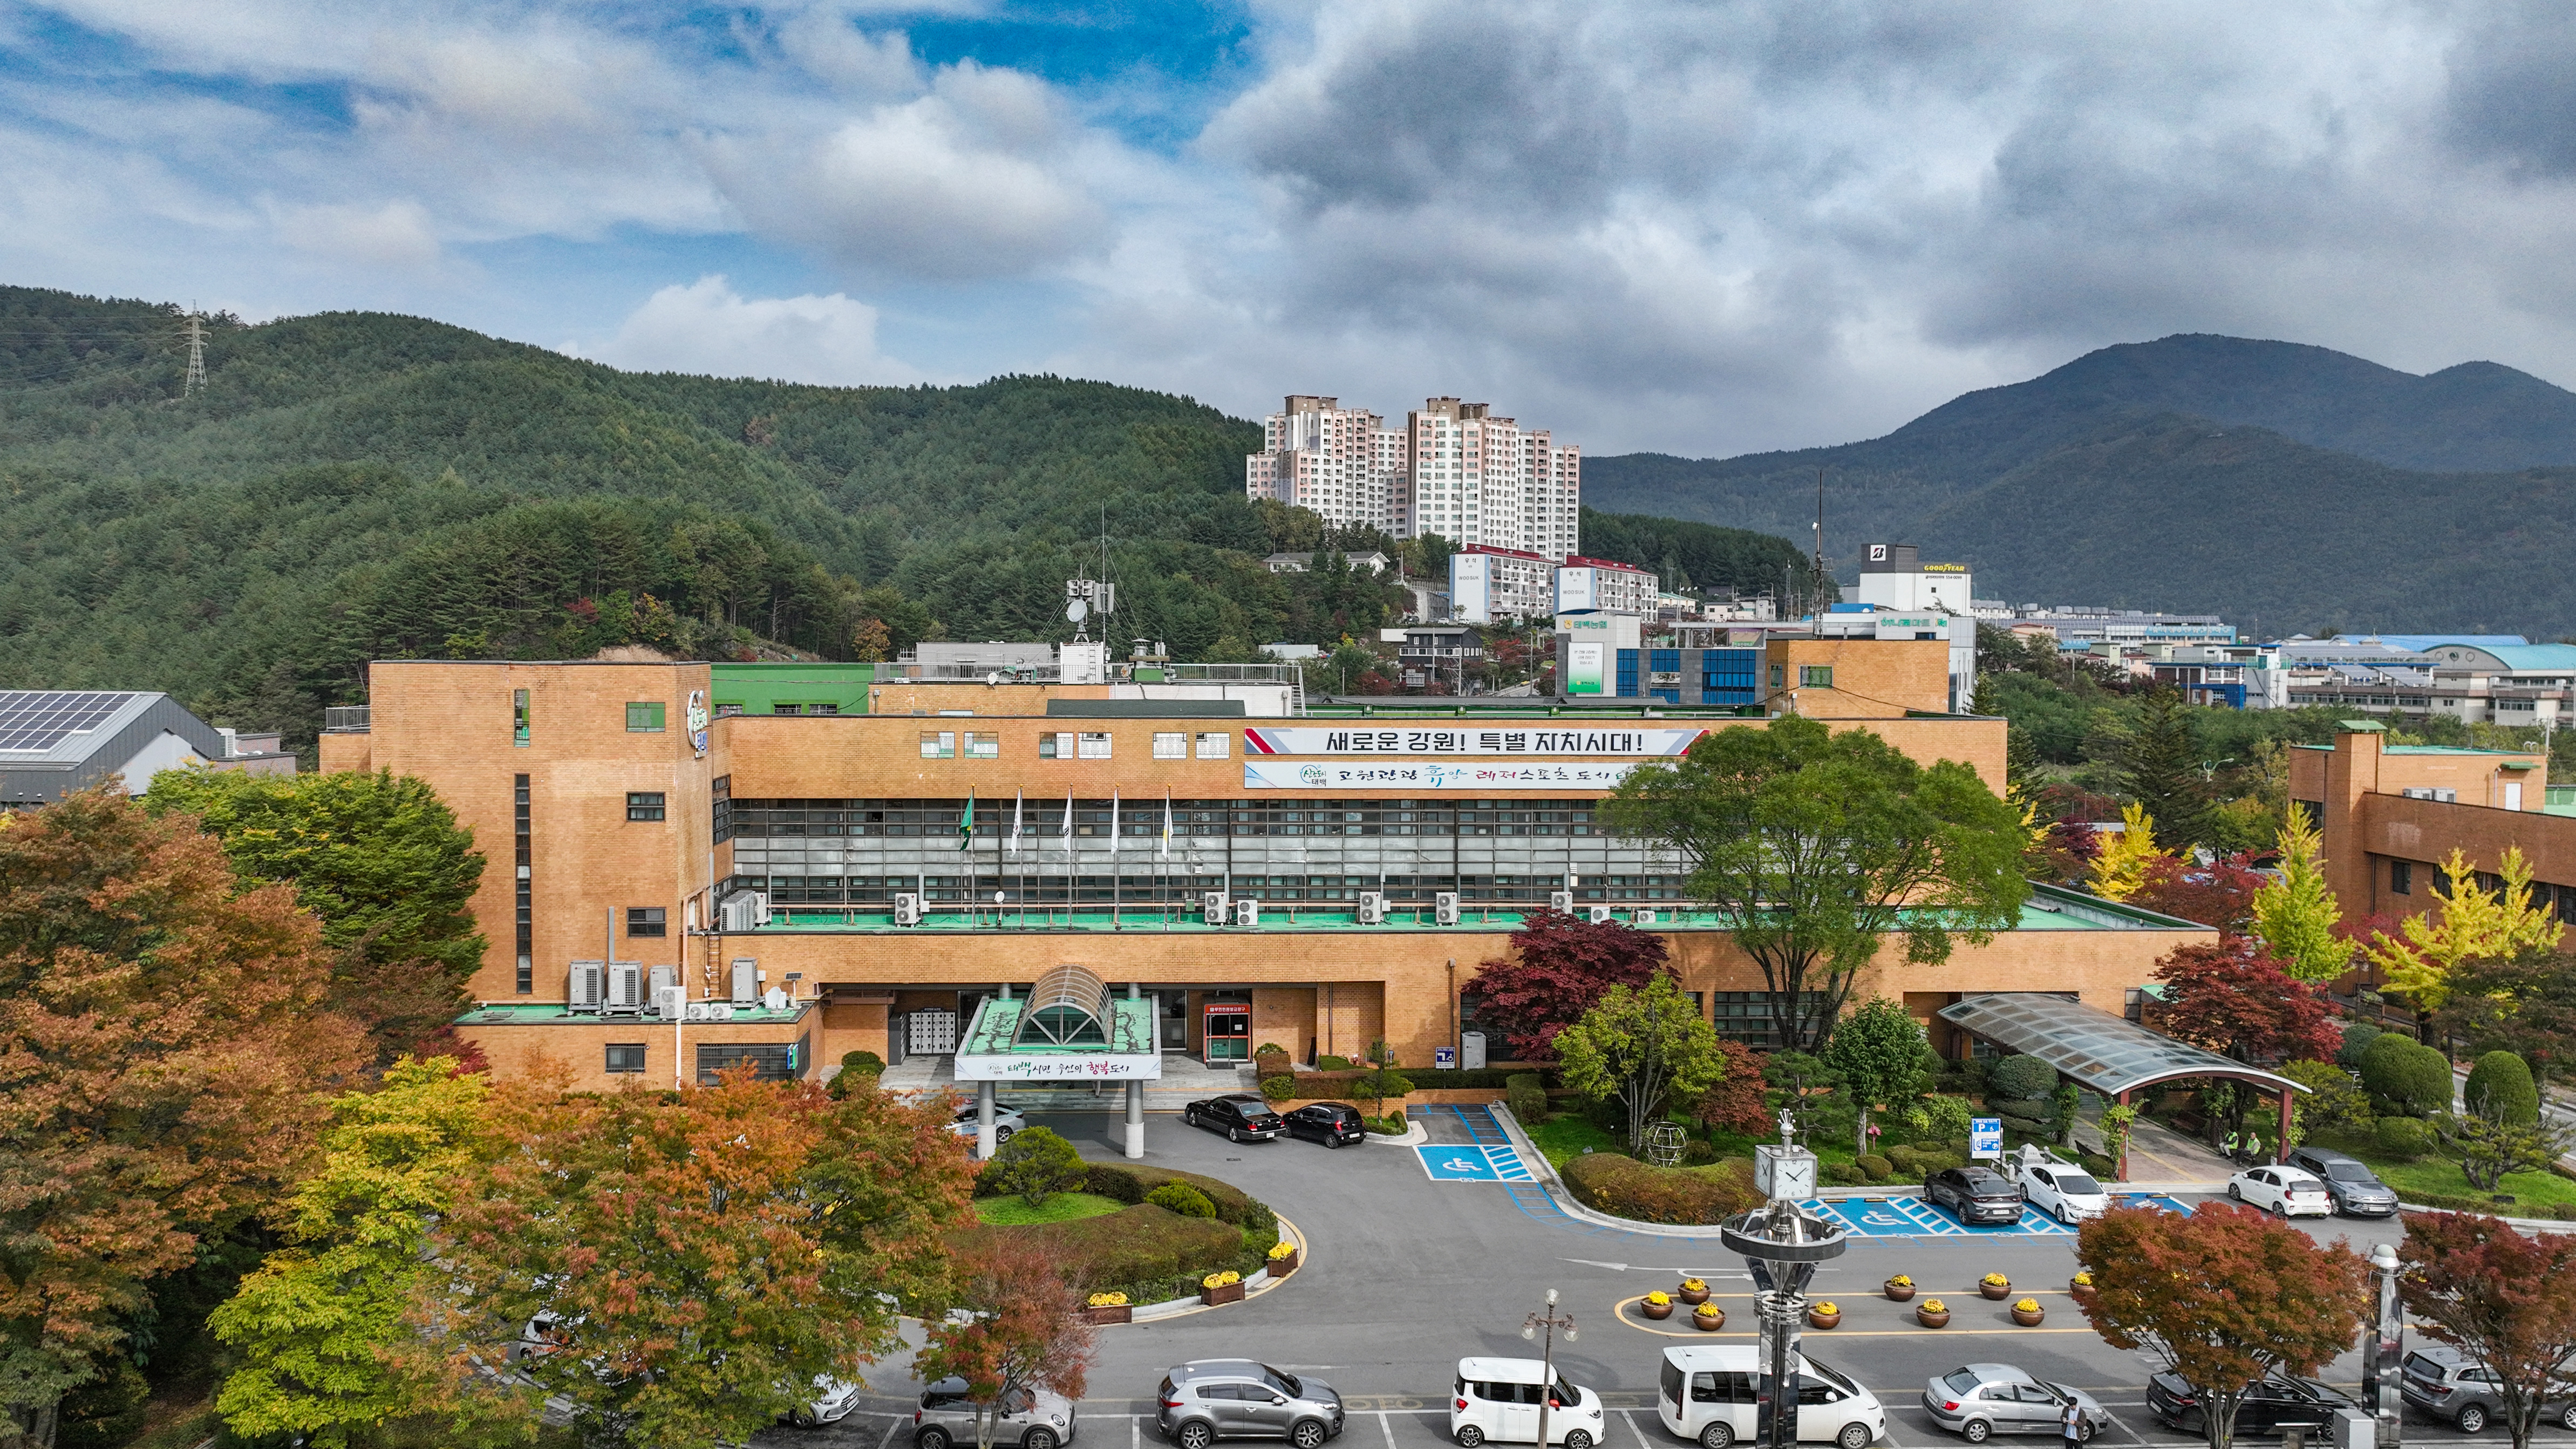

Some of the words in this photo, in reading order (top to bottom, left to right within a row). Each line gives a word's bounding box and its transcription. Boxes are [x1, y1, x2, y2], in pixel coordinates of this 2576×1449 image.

[1924, 564, 1965, 572] GOODYEAR
[1573, 621, 1607, 629] 태백농협
[1880, 617, 1930, 627] 하나로마트
[1326, 732, 1399, 751] 새로운
[1408, 732, 1465, 751] 강원!
[1480, 733, 1526, 751] 특별
[1535, 732, 1642, 751] 자치시대!
[1424, 765, 1468, 787] 휴양
[1311, 779, 1326, 787] 태백
[1086, 1060, 1130, 1075] 행복도시
[1978, 1124, 1986, 1132] P
